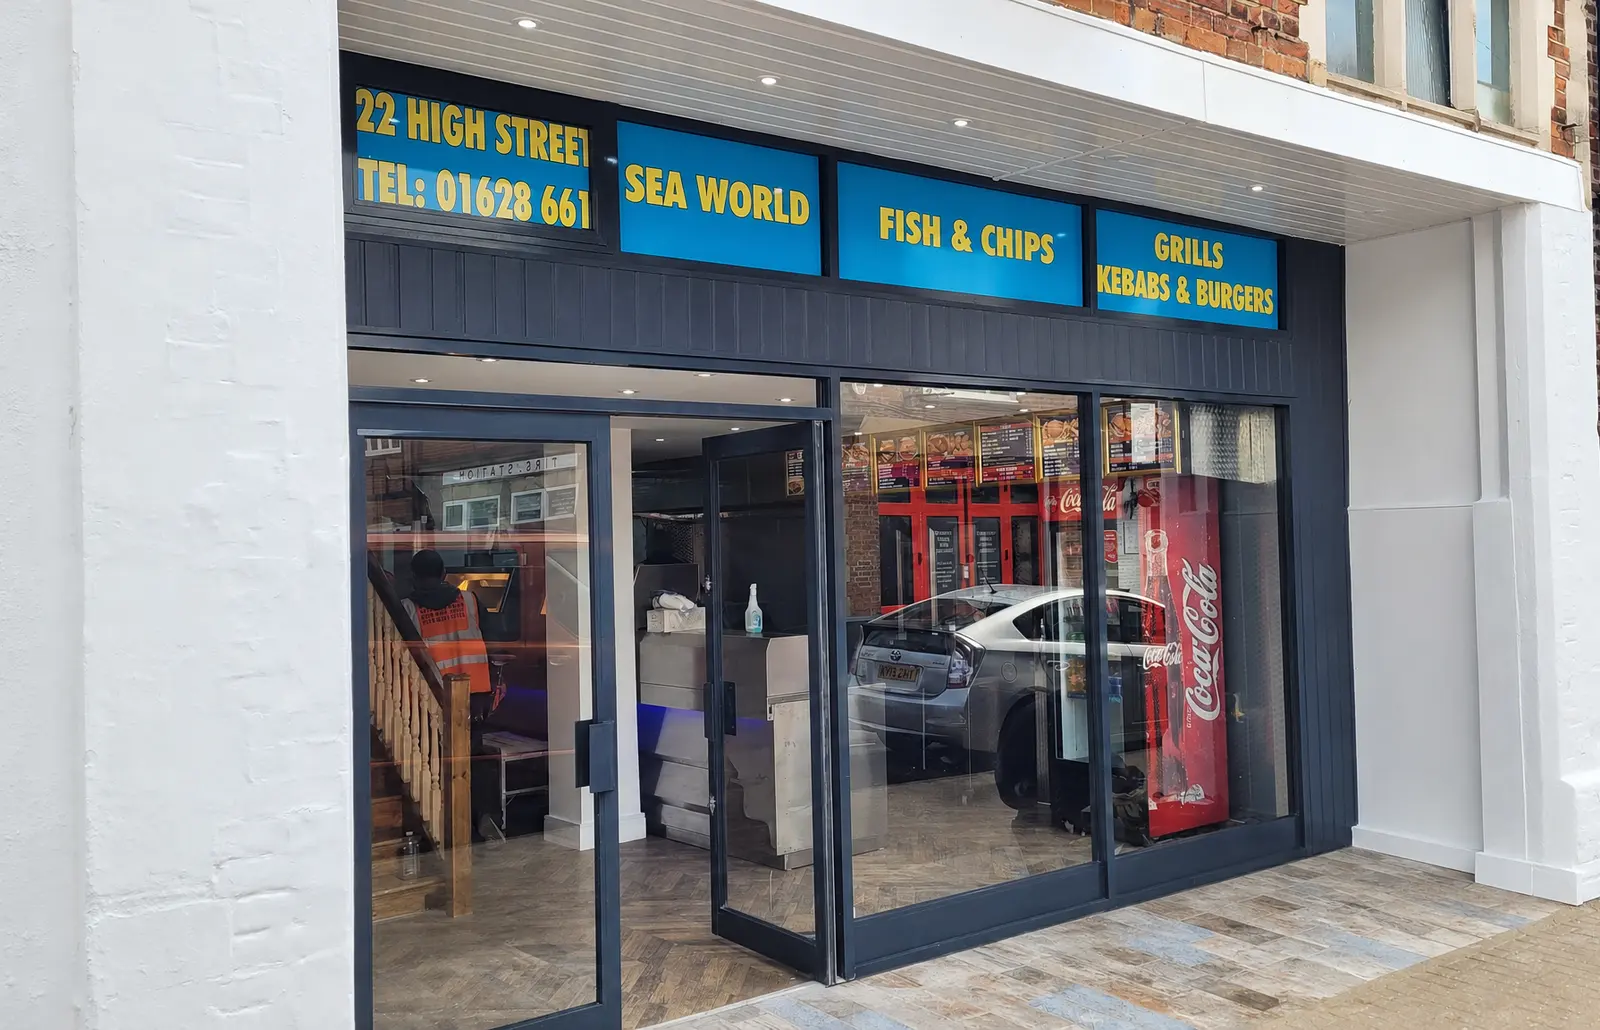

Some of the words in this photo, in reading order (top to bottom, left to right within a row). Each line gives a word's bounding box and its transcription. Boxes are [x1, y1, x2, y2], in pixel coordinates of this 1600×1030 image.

[355, 88, 396, 137] 22
[406, 97, 487, 151] HIGH
[357, 157, 426, 209] TEL:
[436, 168, 533, 222] 01628
[624, 163, 688, 210] SEA
[695, 174, 811, 226] WORLD
[879, 206, 942, 248] FISH
[951, 218, 974, 253] &
[980, 224, 1056, 265] CHIPS
[1154, 231, 1225, 270] GRILLS
[1097, 264, 1171, 302] KEBABS
[1175, 275, 1192, 305] &
[1196, 278, 1274, 316] BURGERS
[1182, 557, 1221, 721] Coca-Cola
